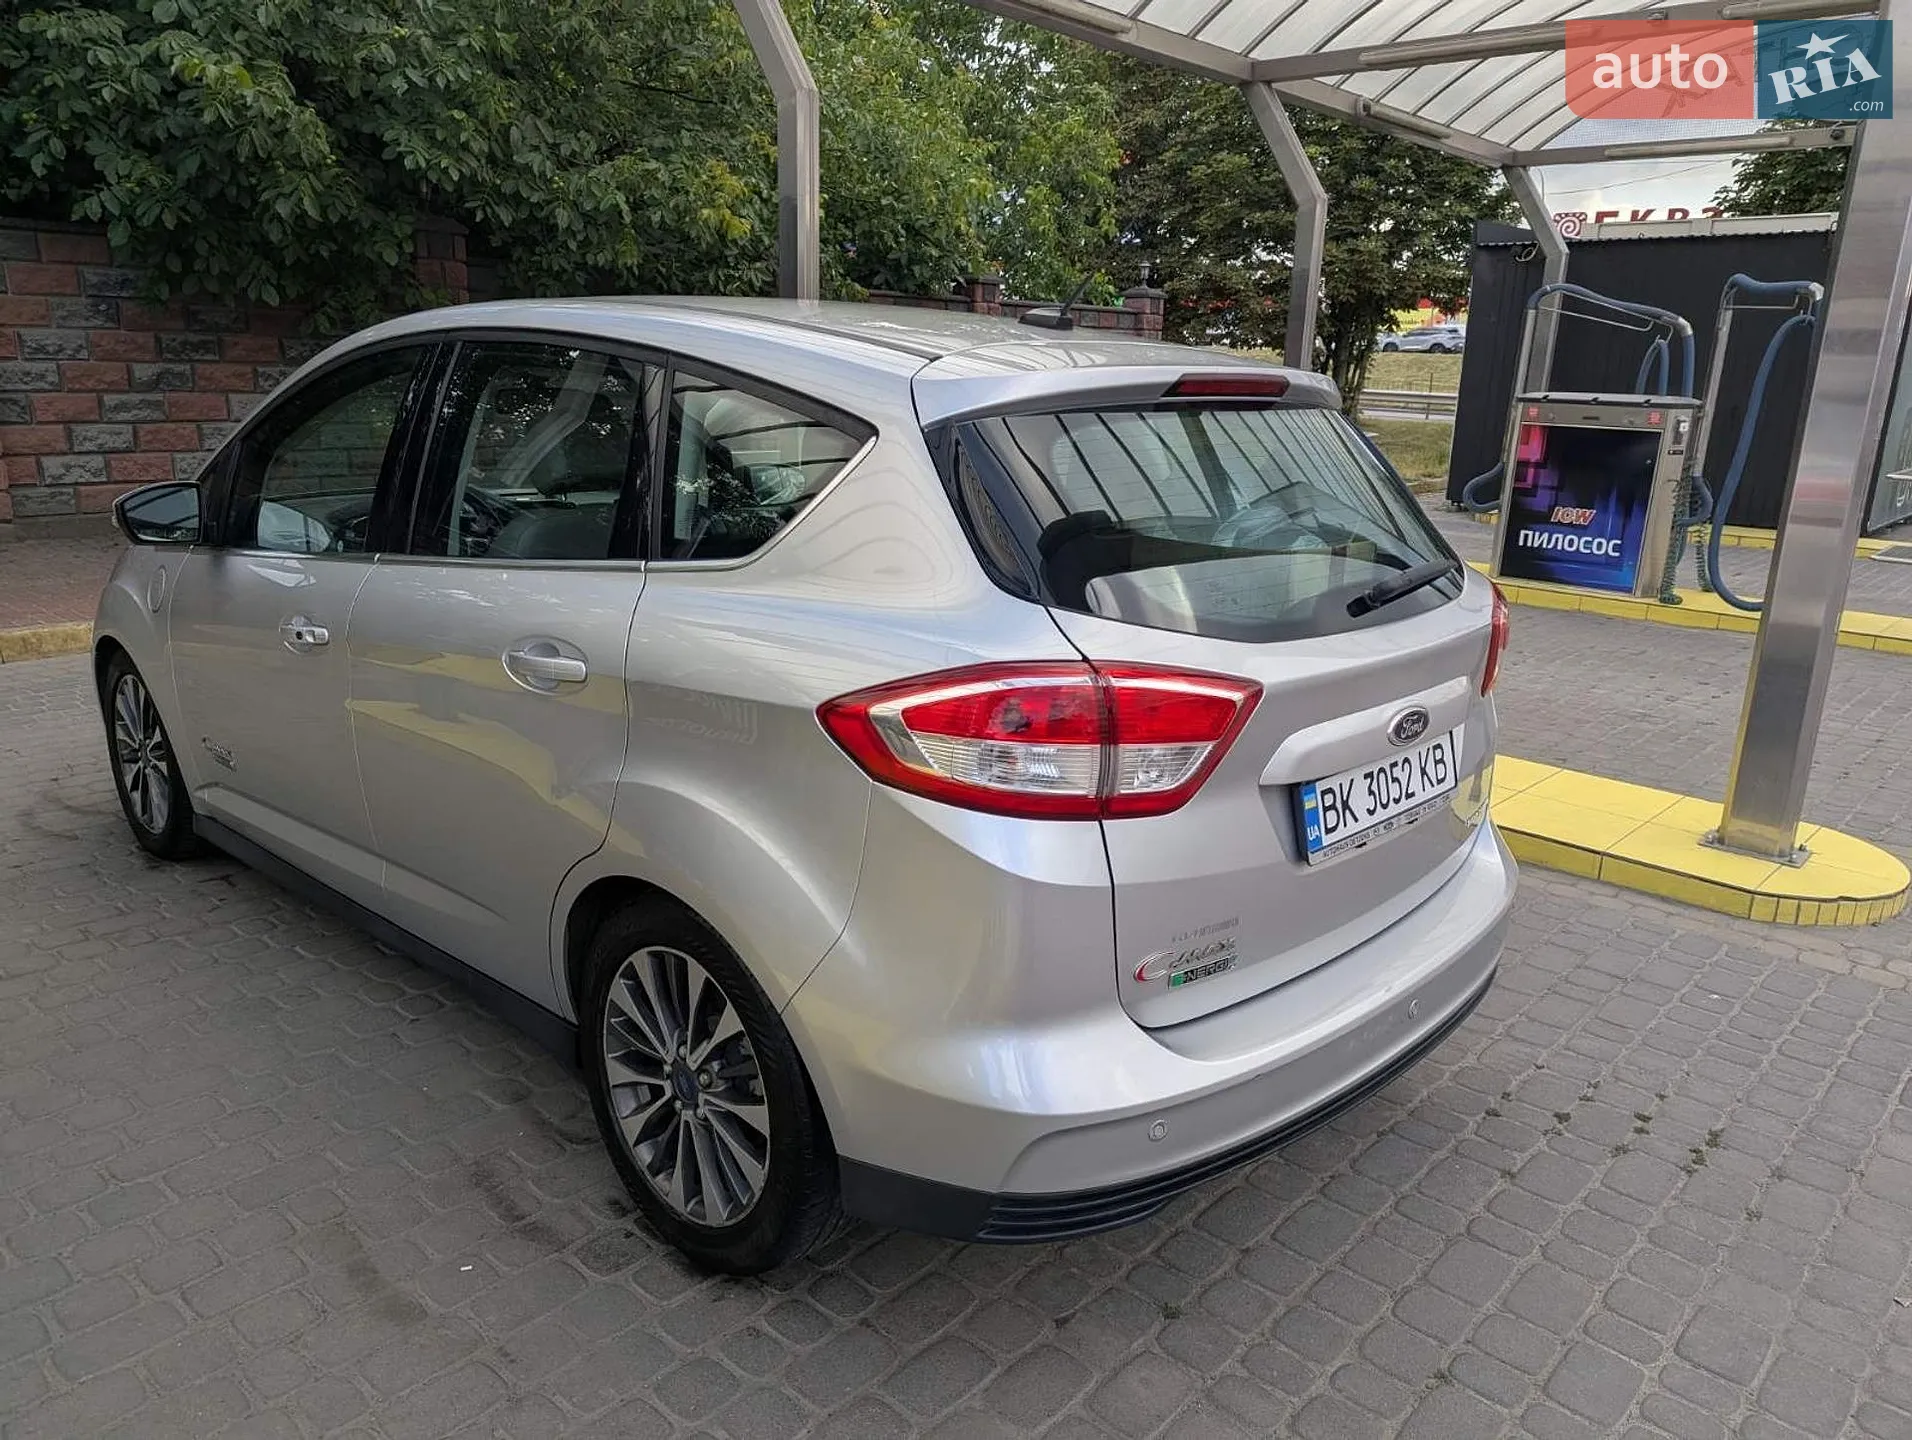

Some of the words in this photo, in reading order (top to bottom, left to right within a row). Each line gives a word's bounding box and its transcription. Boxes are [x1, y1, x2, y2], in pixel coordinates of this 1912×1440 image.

[1518, 529, 1622, 557] ПИЛОСОС
[1401, 712, 1424, 739] Ford
[1320, 779, 1359, 835] BK
[1363, 757, 1415, 816] 3052
[1418, 743, 1447, 792] KB
[1306, 825, 1320, 841] UA
